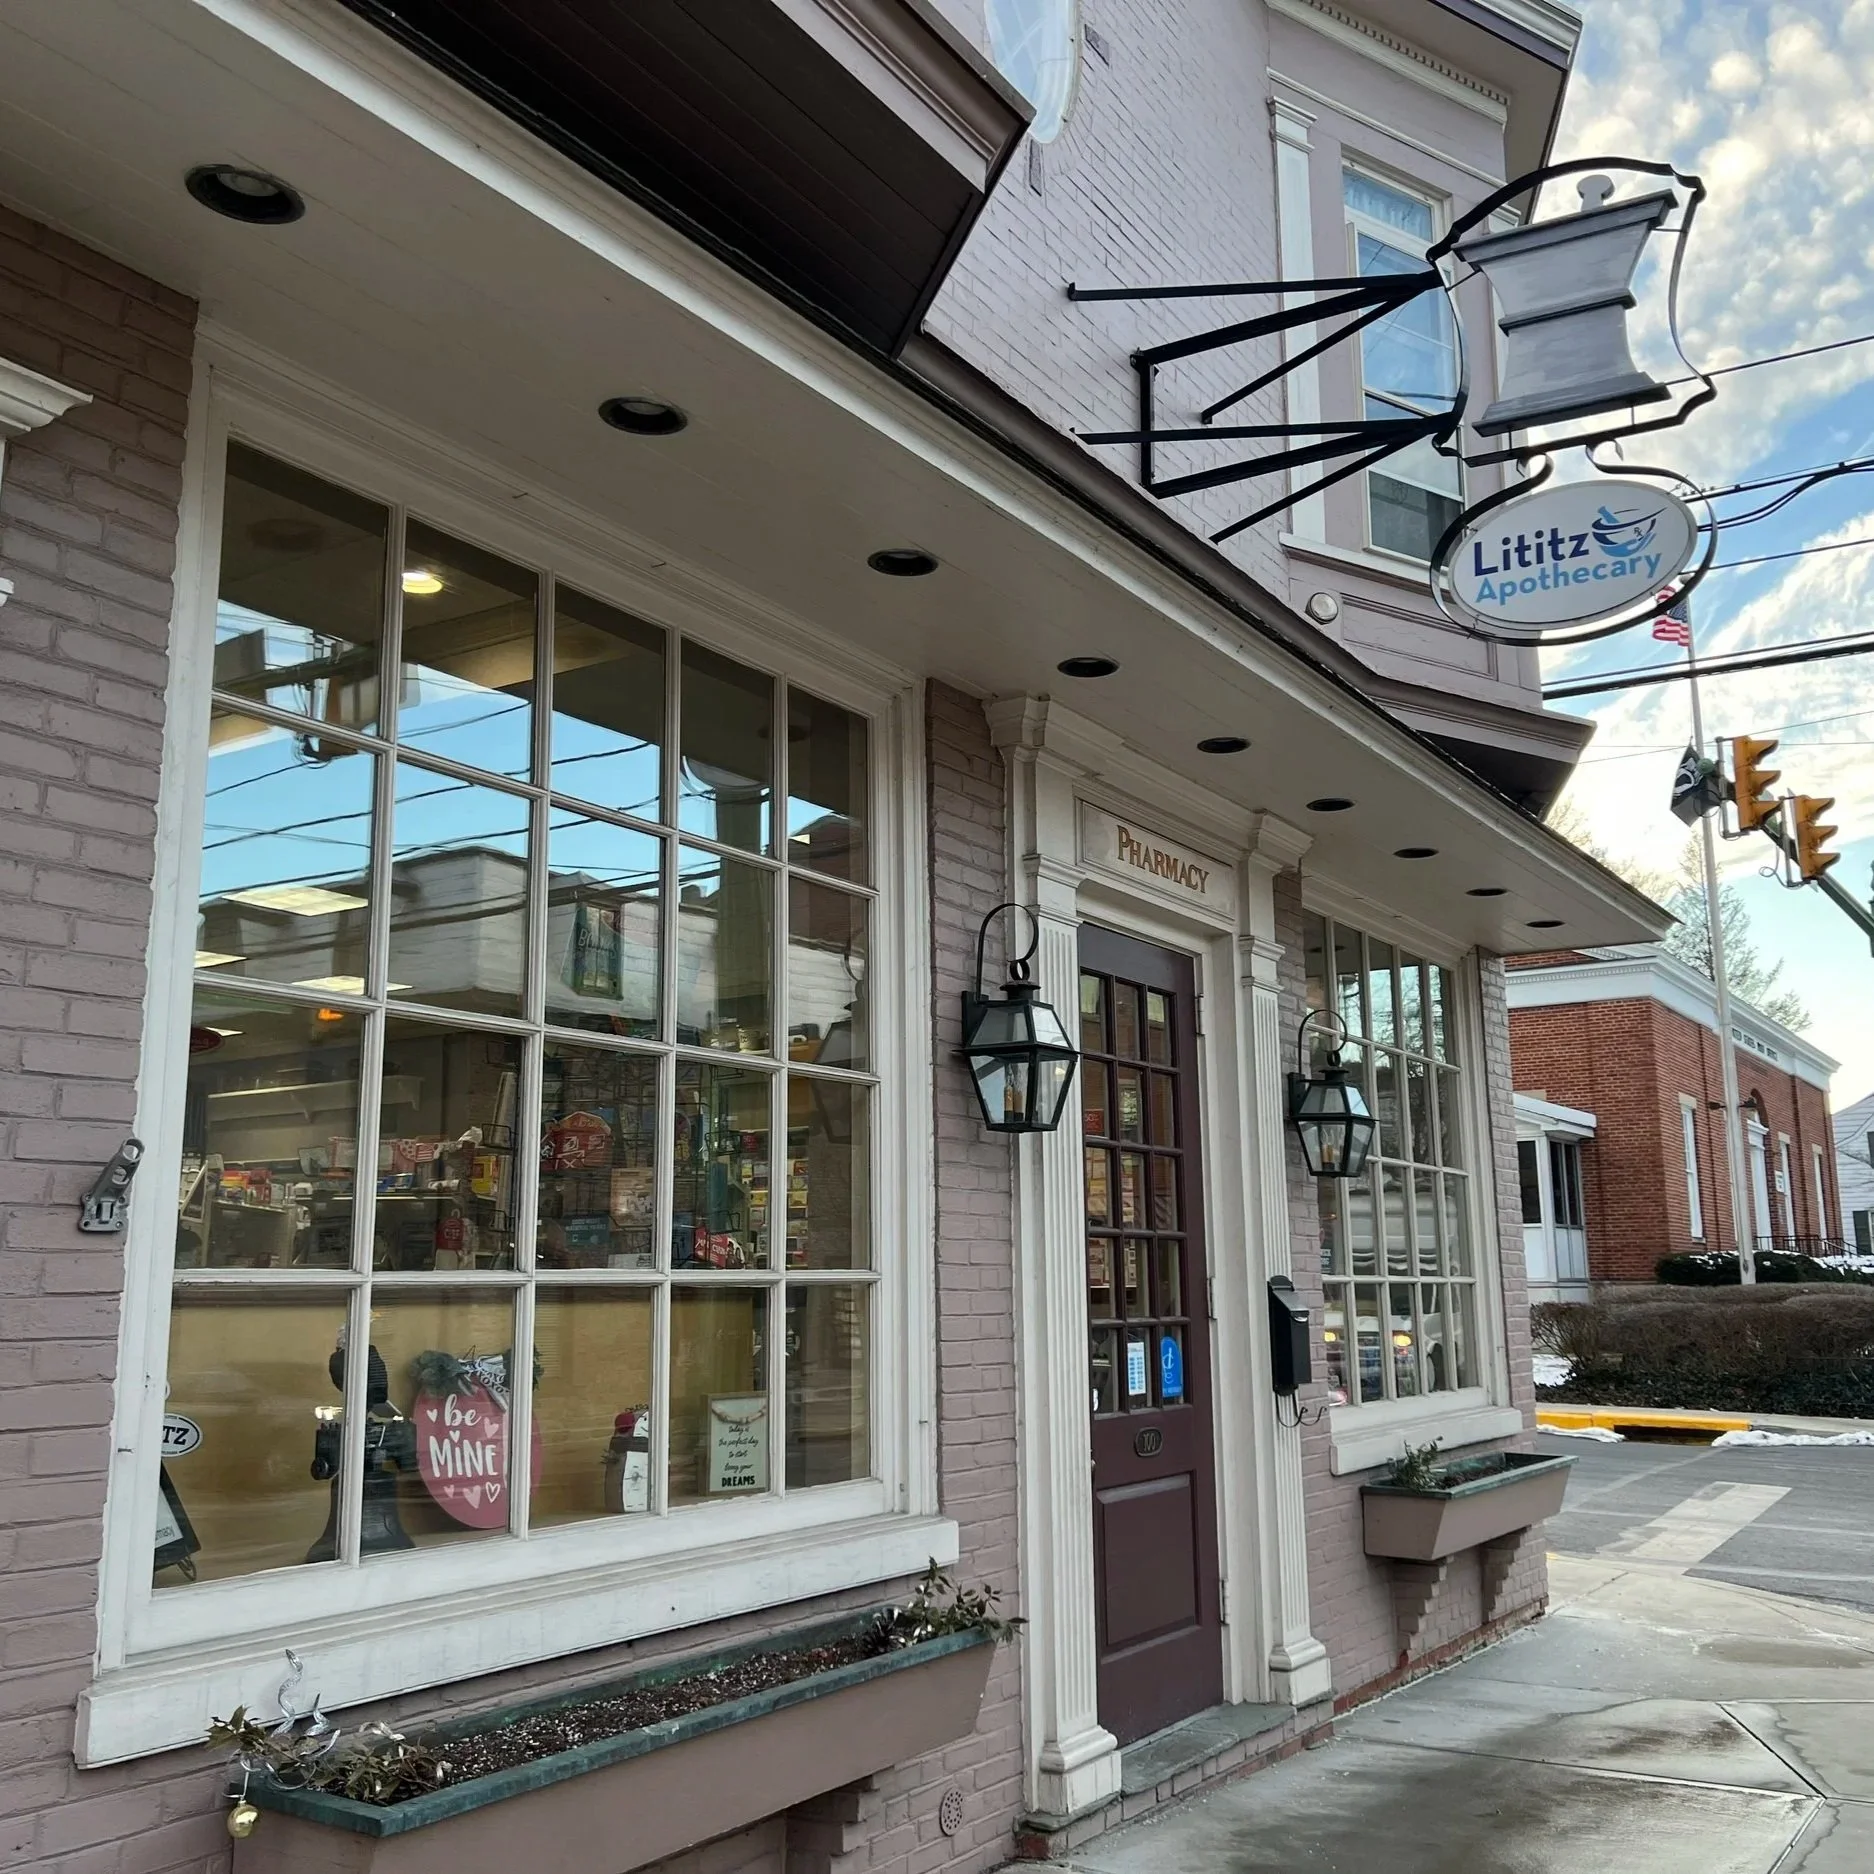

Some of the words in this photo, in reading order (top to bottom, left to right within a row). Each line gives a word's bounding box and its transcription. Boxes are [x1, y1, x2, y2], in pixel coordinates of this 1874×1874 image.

[445, 394, 482, 427] be
[1474, 527, 1589, 577] Lititz
[1476, 552, 1662, 606] Apothecary
[1117, 825, 1209, 893] PHARMACY
[721, 1475, 755, 1488] DREAMS
